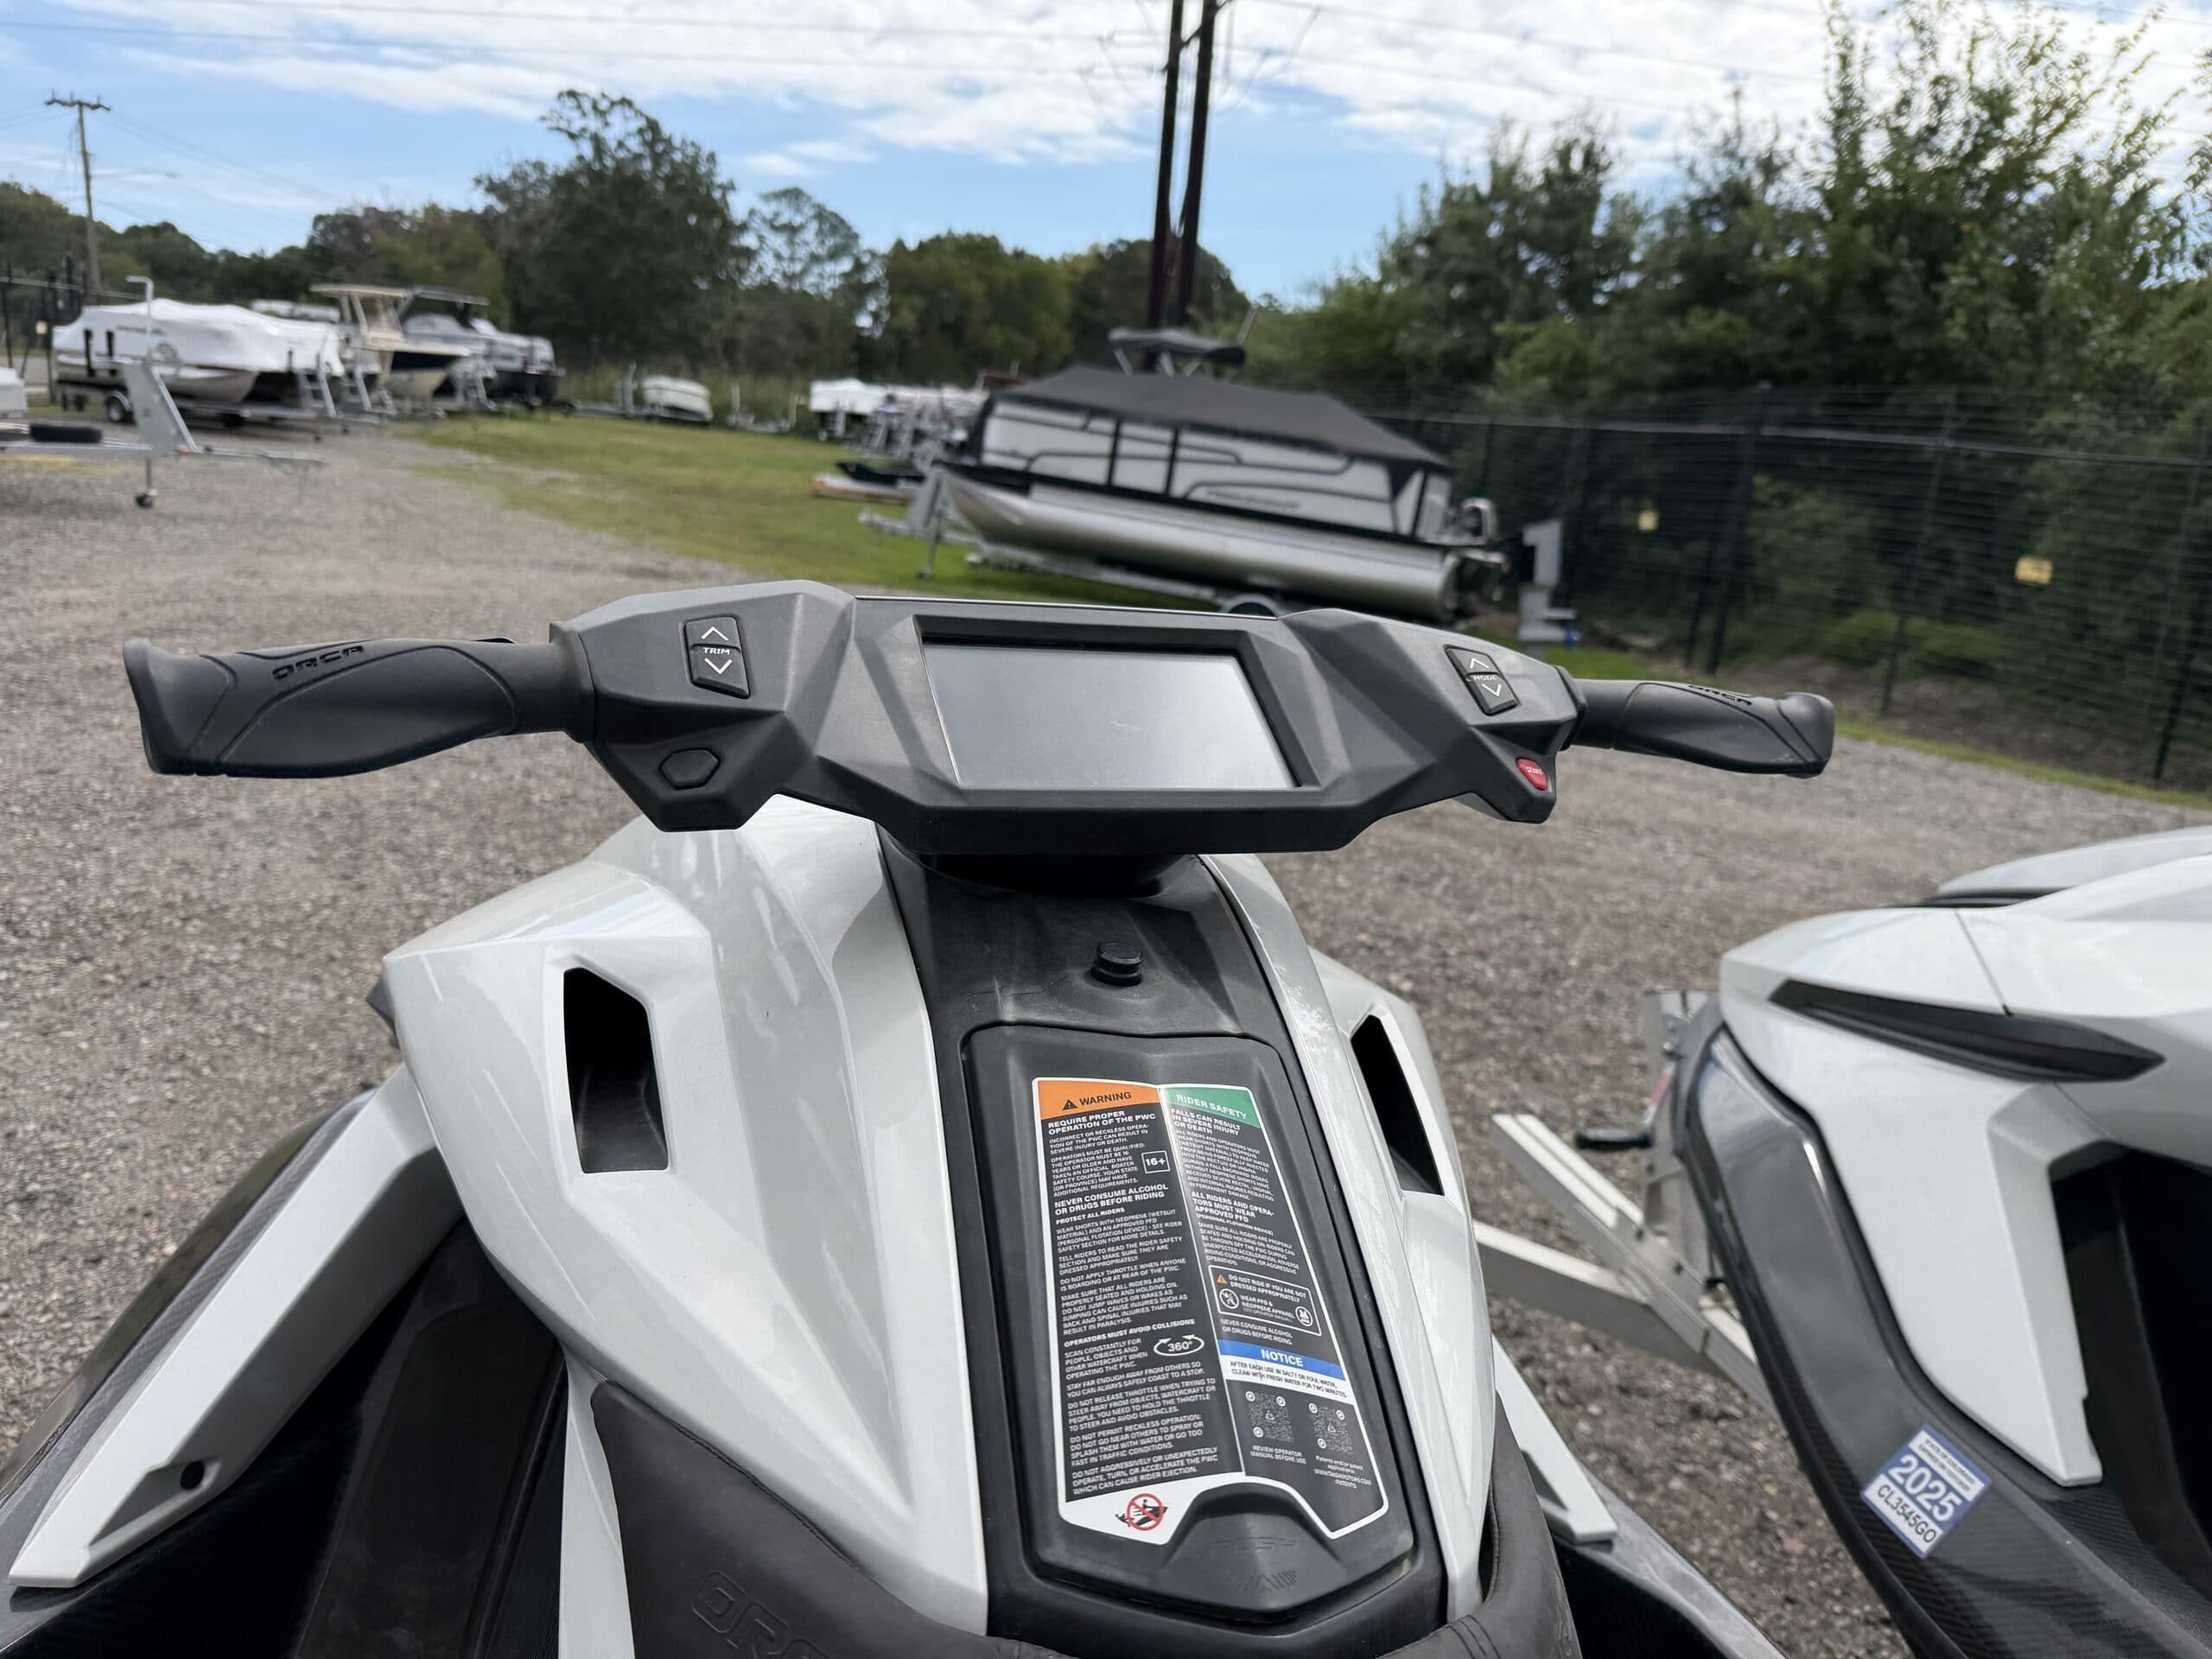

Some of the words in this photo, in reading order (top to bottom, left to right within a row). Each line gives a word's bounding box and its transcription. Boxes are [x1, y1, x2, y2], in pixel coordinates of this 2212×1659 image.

[272, 645, 364, 679] ORCA
[1079, 1091, 1132, 1106] WARNING
[1175, 1094, 1208, 1109] RIDER
[1209, 1102, 1247, 1120] SAFETY
[1048, 1116, 1088, 1128] REQUIRE
[1089, 1110, 1125, 1122] PROPER
[1048, 1121, 1100, 1135] OPERATION
[1170, 1108, 1195, 1118] FALLS
[1196, 1114, 1213, 1123] CAN
[1213, 1118, 1241, 1131] RESULT
[1182, 1116, 1212, 1128] SEVERE
[1213, 1123, 1239, 1135] INJURY
[1186, 1123, 1213, 1135] DEATH
[1145, 1157, 1166, 1166] 16+
[1054, 1197, 1083, 1209] NEVER
[1084, 1189, 1127, 1203] CONSUME
[1128, 1183, 1169, 1195] ALCOHOL
[1054, 1207, 1068, 1216] OR
[1069, 1201, 1099, 1213] DRUGS
[1099, 1195, 1134, 1207] BEFORE
[1134, 1191, 1165, 1201] RIDING
[1190, 1190, 1205, 1199] ALL
[1205, 1193, 1232, 1205] RIDERS
[1233, 1200, 1249, 1210] AND
[1056, 1214, 1086, 1225] PROTECT
[1100, 1207, 1125, 1216] RIDERS
[1192, 1198, 1213, 1207] TORS
[1213, 1202, 1234, 1212] MUST
[1234, 1207, 1256, 1218] WEAR
[1193, 1204, 1234, 1219] APPROVED
[1234, 1213, 1249, 1223] PFD
[1064, 1333, 1107, 1348] OPERATORS
[1107, 1329, 1128, 1338] MUST
[1128, 1325, 1151, 1335] AVOID
[1151, 1319, 1195, 1331] COLLISIONS
[1064, 1349, 1084, 1358] SCAN
[1084, 1340, 1127, 1354] CONSTANTLY
[1127, 1338, 1141, 1346] FOR
[1093, 1348, 1123, 1360] OBJECTS
[1123, 1345, 1139, 1354] AND
[1261, 1349, 1304, 1367] NOTICE
[1065, 1363, 1087, 1373] OTHER
[1086, 1354, 1128, 1369] WATERCRAFT
[1128, 1351, 1148, 1360] WHEN
[1065, 1367, 1104, 1381] OPERATING
[1104, 1363, 1119, 1372] THE
[1066, 1382, 1082, 1391] STAY
[1083, 1379, 1096, 1388] FAR
[1096, 1374, 1125, 1385] ENOUGH
[1125, 1370, 1144, 1379] AWAY
[1144, 1366, 1165, 1376] FROM
[1164, 1362, 1191, 1372] OTHERS
[1066, 1389, 1082, 1398] YOU
[1081, 1387, 1096, 1395] CAN
[1096, 1381, 1123, 1392] ALWAYS
[1122, 1376, 1147, 1387] SAFELY
[1147, 1372, 1169, 1382] COAST
[1067, 1402, 1078, 1410] DO
[1078, 1398, 1093, 1407] NOT
[1094, 1392, 1124, 1404] RELEASE
[1124, 1385, 1159, 1397] THROTTLE
[1159, 1382, 1180, 1391] WHEN
[1180, 1378, 1206, 1388] TRYING
[1068, 1407, 1090, 1417] STEER
[1090, 1403, 1109, 1412] AWAY
[1109, 1399, 1129, 1408] FROM
[1160, 1386, 1205, 1399] WATERCRAFT
[1111, 1406, 1131, 1415] NEED
[1141, 1401, 1161, 1409] HOLD
[1176, 1393, 1211, 1404] THROTTLE
[1070, 1435, 1082, 1444] DO
[1081, 1432, 1096, 1441] NOT
[1097, 1427, 1123, 1438] PERMIT
[1124, 1420, 1160, 1432] RECKLESS
[1079, 1420, 1101, 1430] STEER
[1101, 1416, 1116, 1426] AND
[1116, 1413, 1139, 1422] AVOID
[1070, 1443, 1082, 1452] DO
[1082, 1440, 1096, 1449] NOT
[1097, 1437, 1109, 1446] GO
[1109, 1433, 1130, 1443] NEAR
[1130, 1427, 1159, 1440] OTHERS
[1169, 1422, 1192, 1433] SPRAY
[1071, 1447, 1099, 1459] SPLASH
[1098, 1443, 1120, 1453] THEM
[1119, 1440, 1139, 1449] WITH
[1139, 1435, 1164, 1446] WATER
[1163, 1433, 1175, 1441] OR
[1175, 1431, 1187, 1440] GO
[1187, 1428, 1203, 1437] TOO
[1071, 1458, 1089, 1466] FAST
[1098, 1450, 1128, 1461] TRAFFIC
[1071, 1471, 1084, 1479] DO
[1084, 1466, 1099, 1477] NOT
[1100, 1457, 1152, 1472] AGGRESSIVELY
[1152, 1454, 1164, 1463] OR
[1163, 1446, 1217, 1461] UNEXPECTEDLY
[1128, 1467, 1141, 1476] OR
[1141, 1459, 1185, 1473] ACCELERATE
[1201, 1454, 1218, 1463] PWC
[1072, 1484, 1098, 1495] WHICH
[1098, 1481, 1115, 1490] CAN
[1115, 1475, 1139, 1486] CAUSE
[1139, 1471, 1162, 1481] RIDER
[1888, 1453, 1963, 1522] 2025
[1878, 1484, 1937, 1543] CL3545GO
